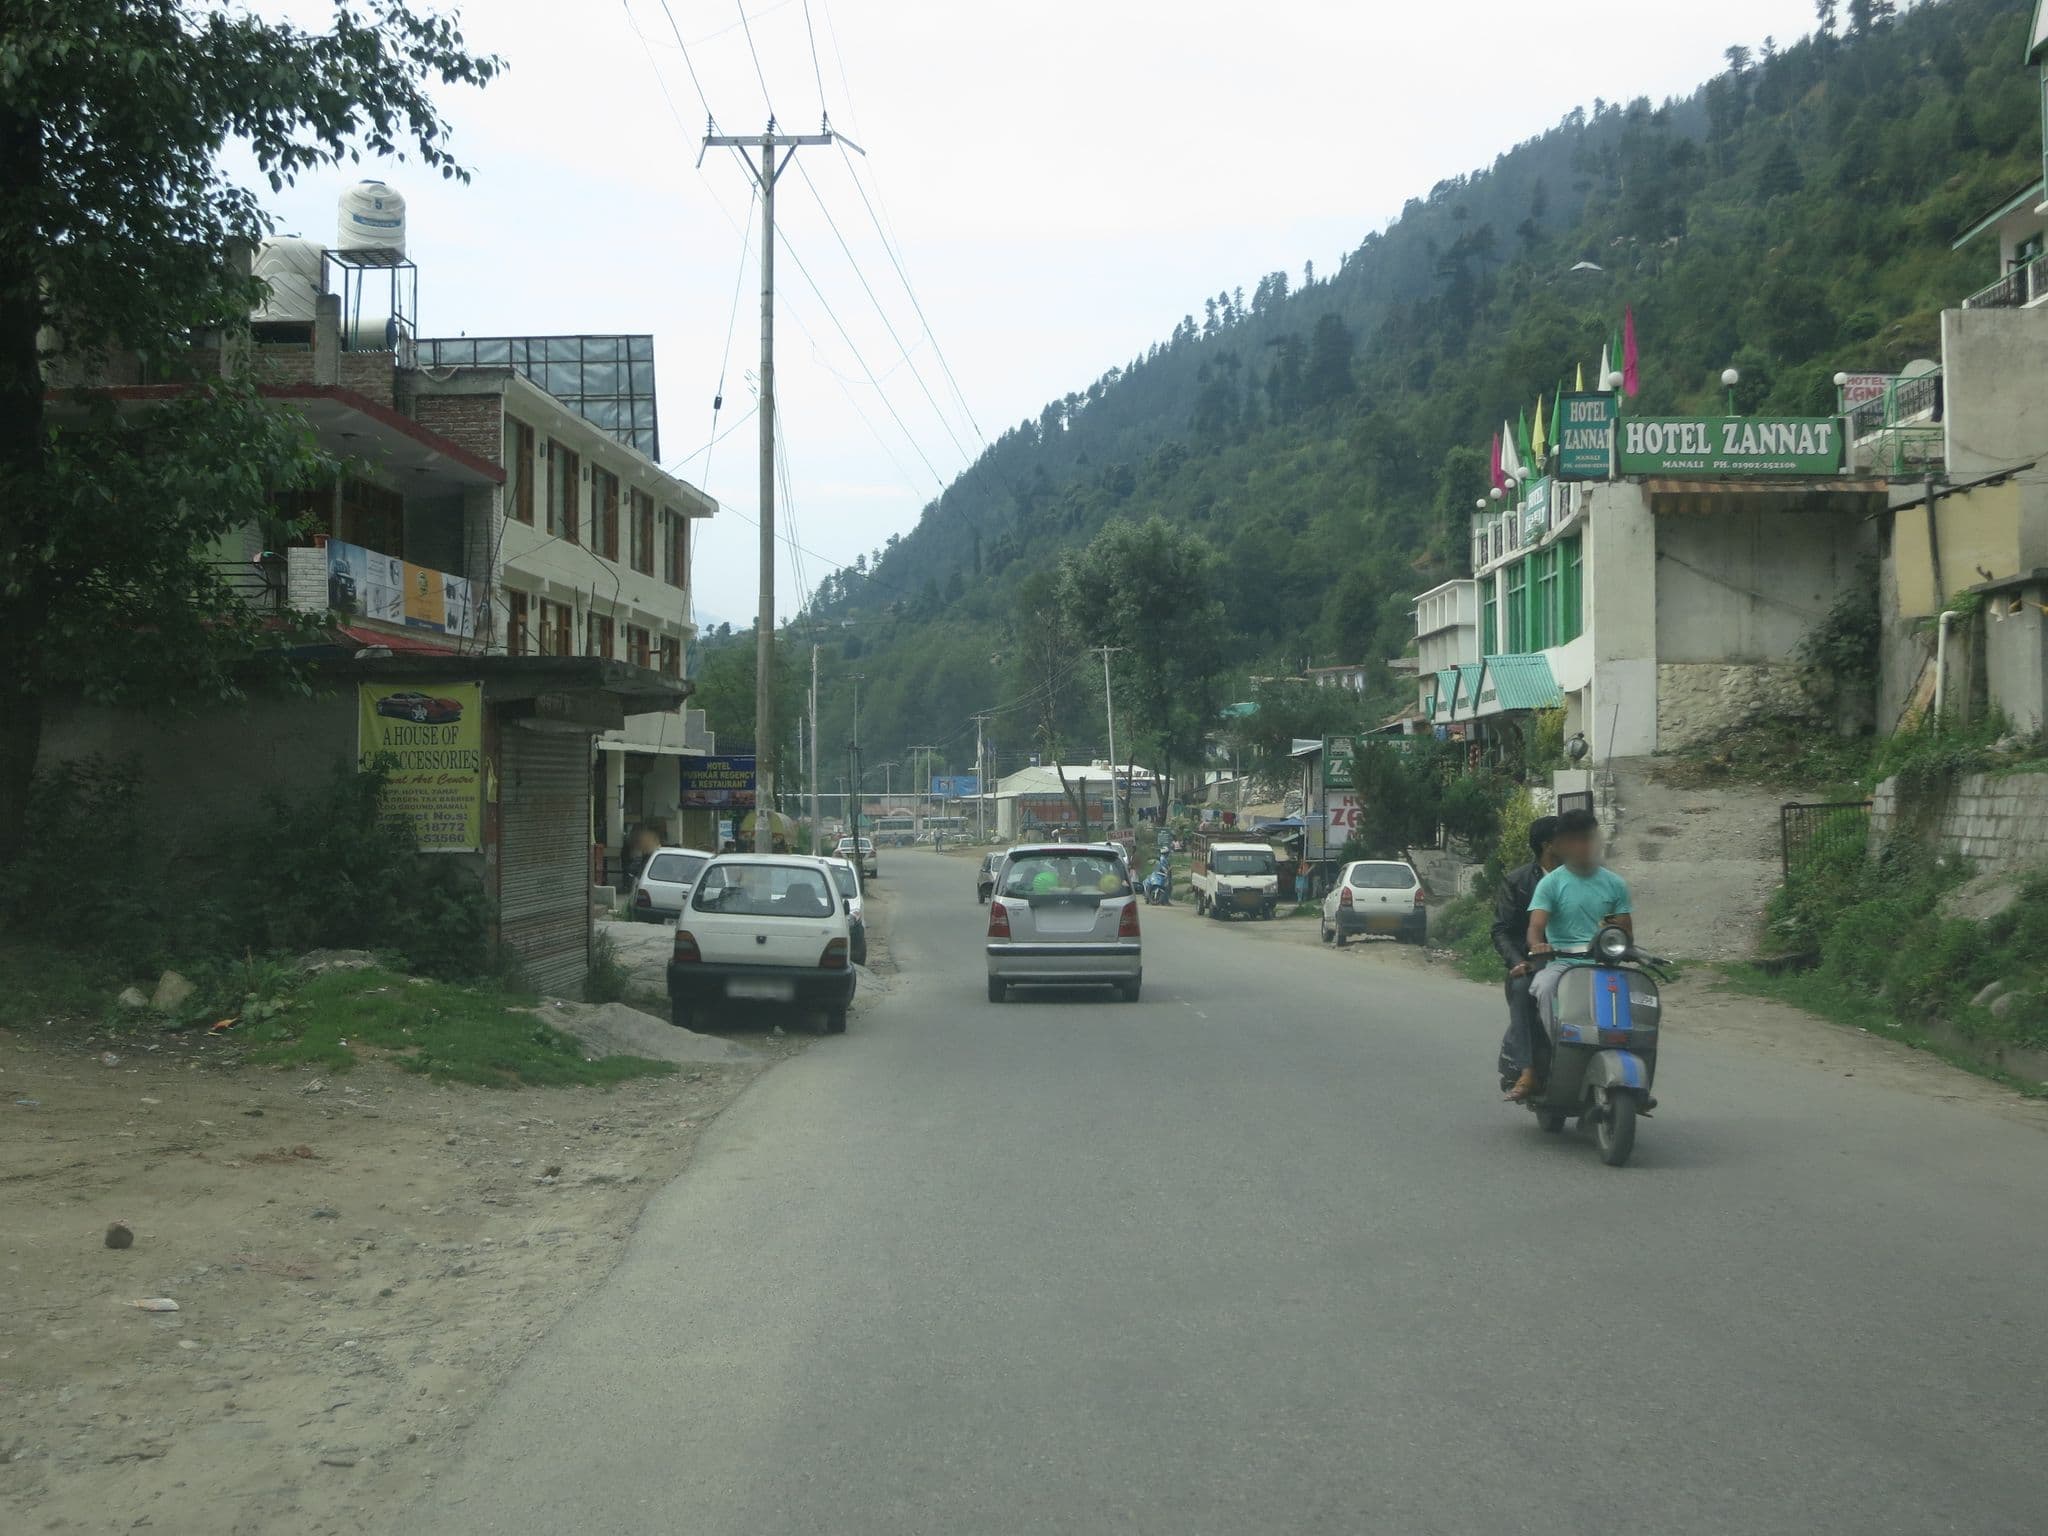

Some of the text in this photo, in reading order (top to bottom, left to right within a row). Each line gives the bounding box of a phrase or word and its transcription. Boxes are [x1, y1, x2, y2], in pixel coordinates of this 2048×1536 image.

[1570, 401, 1607, 422] HOTEL
[1625, 422, 1832, 456] HOTEL ZANNAT
[1662, 460, 1704, 468] MANALI
[1713, 460, 1729, 469] PH.
[383, 725, 460, 746] A HOUSE OF
[393, 750, 480, 770] CCESSORIES
[706, 761, 731, 770] HOTEL
[437, 773, 475, 785] Centre
[720, 770, 755, 779] REGENCY
[699, 780, 748, 788] RESTAURANT
